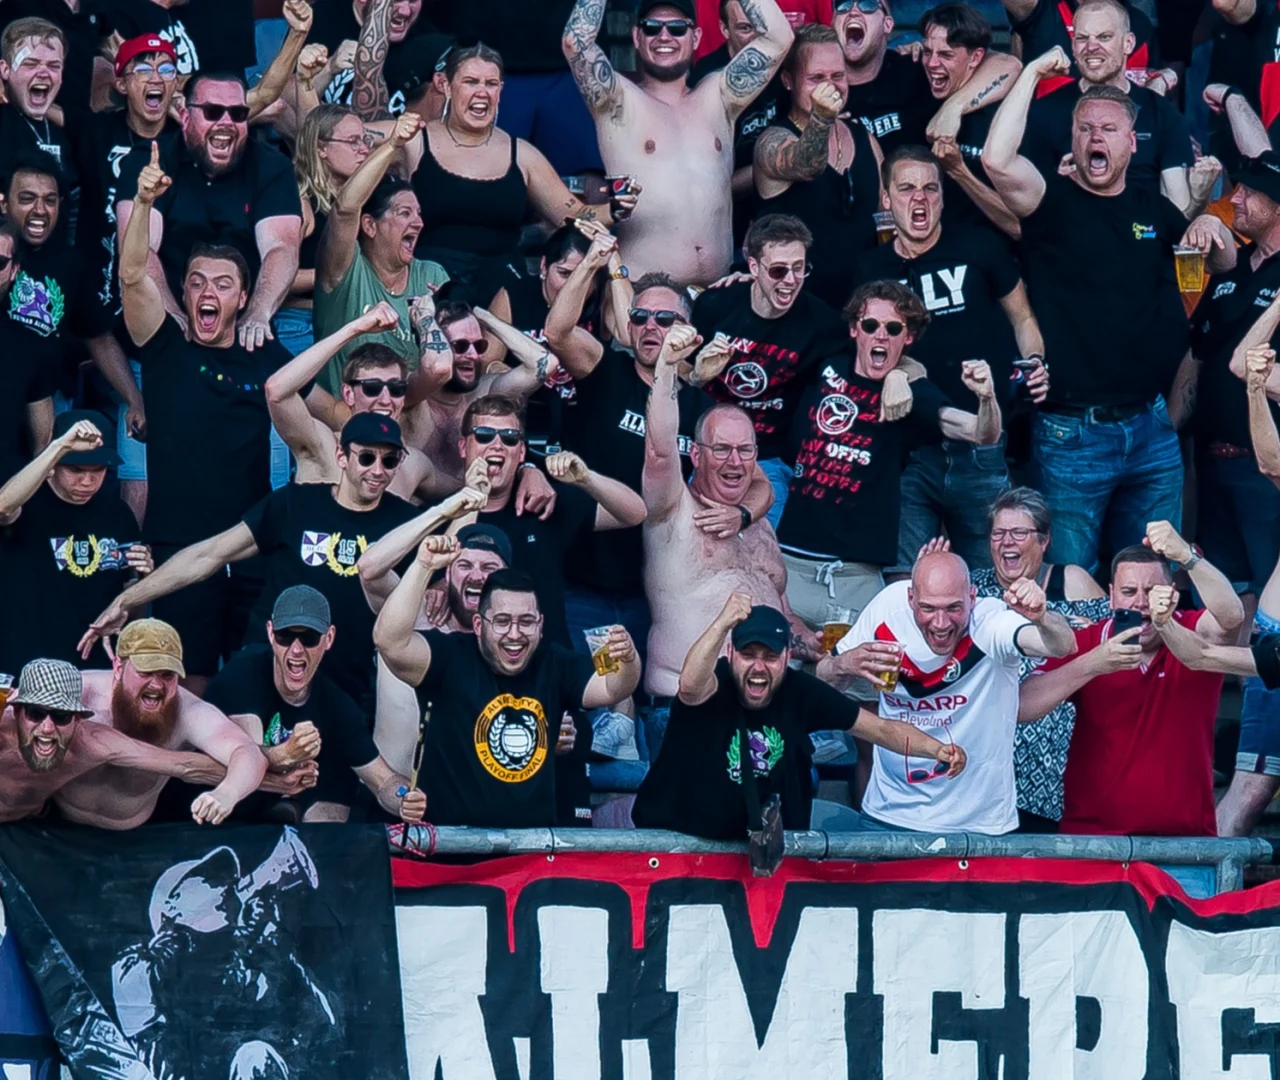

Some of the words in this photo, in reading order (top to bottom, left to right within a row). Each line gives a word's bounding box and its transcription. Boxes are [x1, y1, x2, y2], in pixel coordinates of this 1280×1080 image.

[883, 693, 968, 712] SHARP
[479, 748, 518, 781] PLAYOFF
[519, 757, 544, 780] FINAL
